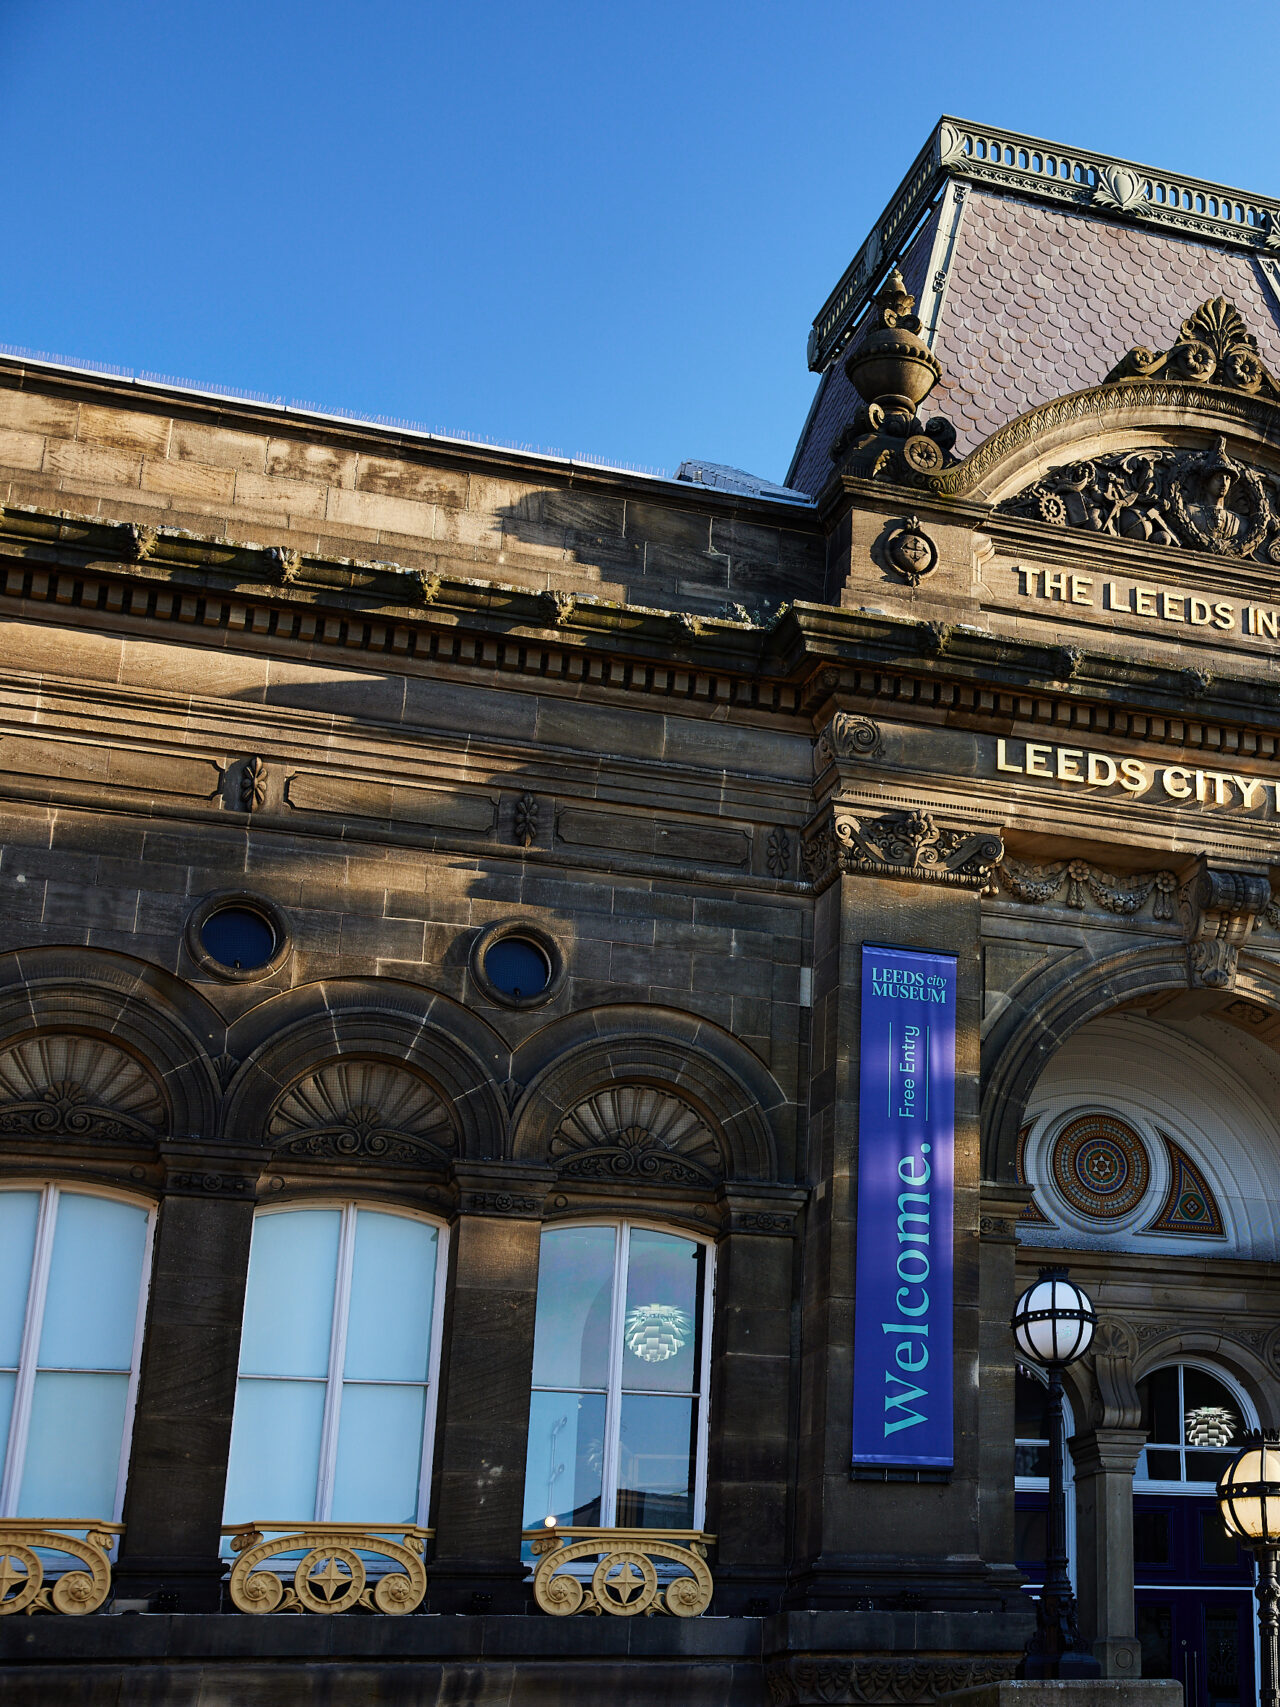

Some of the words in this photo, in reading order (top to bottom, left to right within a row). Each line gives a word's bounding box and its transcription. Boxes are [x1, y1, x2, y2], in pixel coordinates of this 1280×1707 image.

[1018, 565, 1094, 606] THE
[1109, 582, 1235, 630] LEEDS
[997, 739, 1147, 792] LEEDS
[1162, 765, 1262, 809] CITY
[872, 967, 924, 986] LEEDS
[926, 974, 947, 989] city
[872, 982, 946, 1004] MUSEUM
[899, 1025, 920, 1073] Entry
[899, 1078, 915, 1118] Free
[881, 1142, 932, 1438] Welcome.
